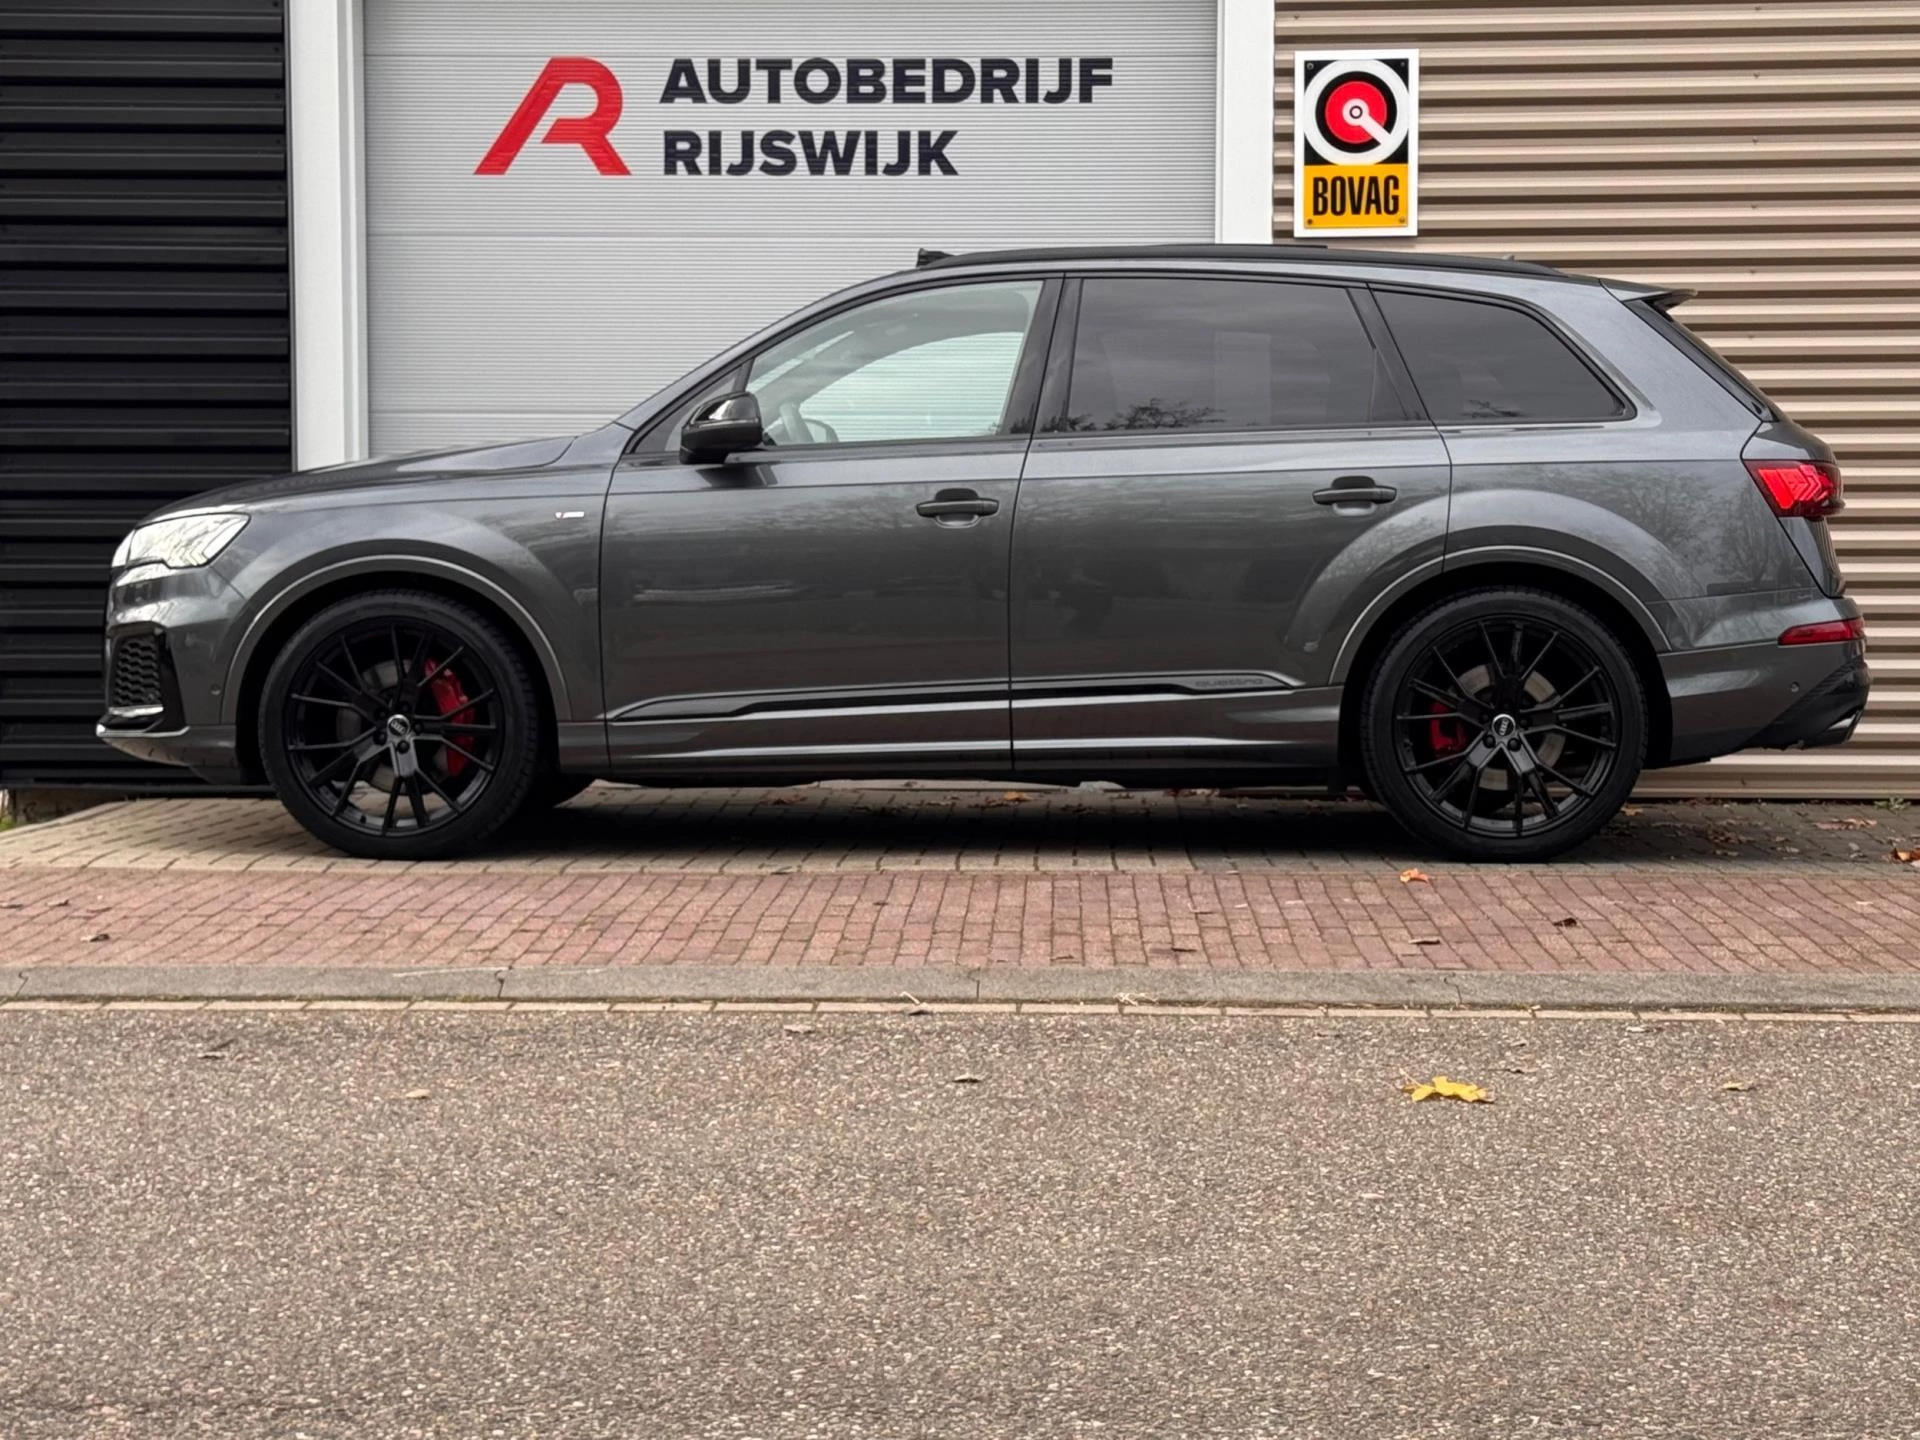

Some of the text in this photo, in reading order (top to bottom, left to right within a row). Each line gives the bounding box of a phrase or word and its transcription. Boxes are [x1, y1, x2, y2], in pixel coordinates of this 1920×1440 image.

[659, 57, 1113, 105] AUTOBEDRIJF
[663, 129, 959, 177] RIJSWIJK
[1312, 174, 1400, 217] BOVAG
